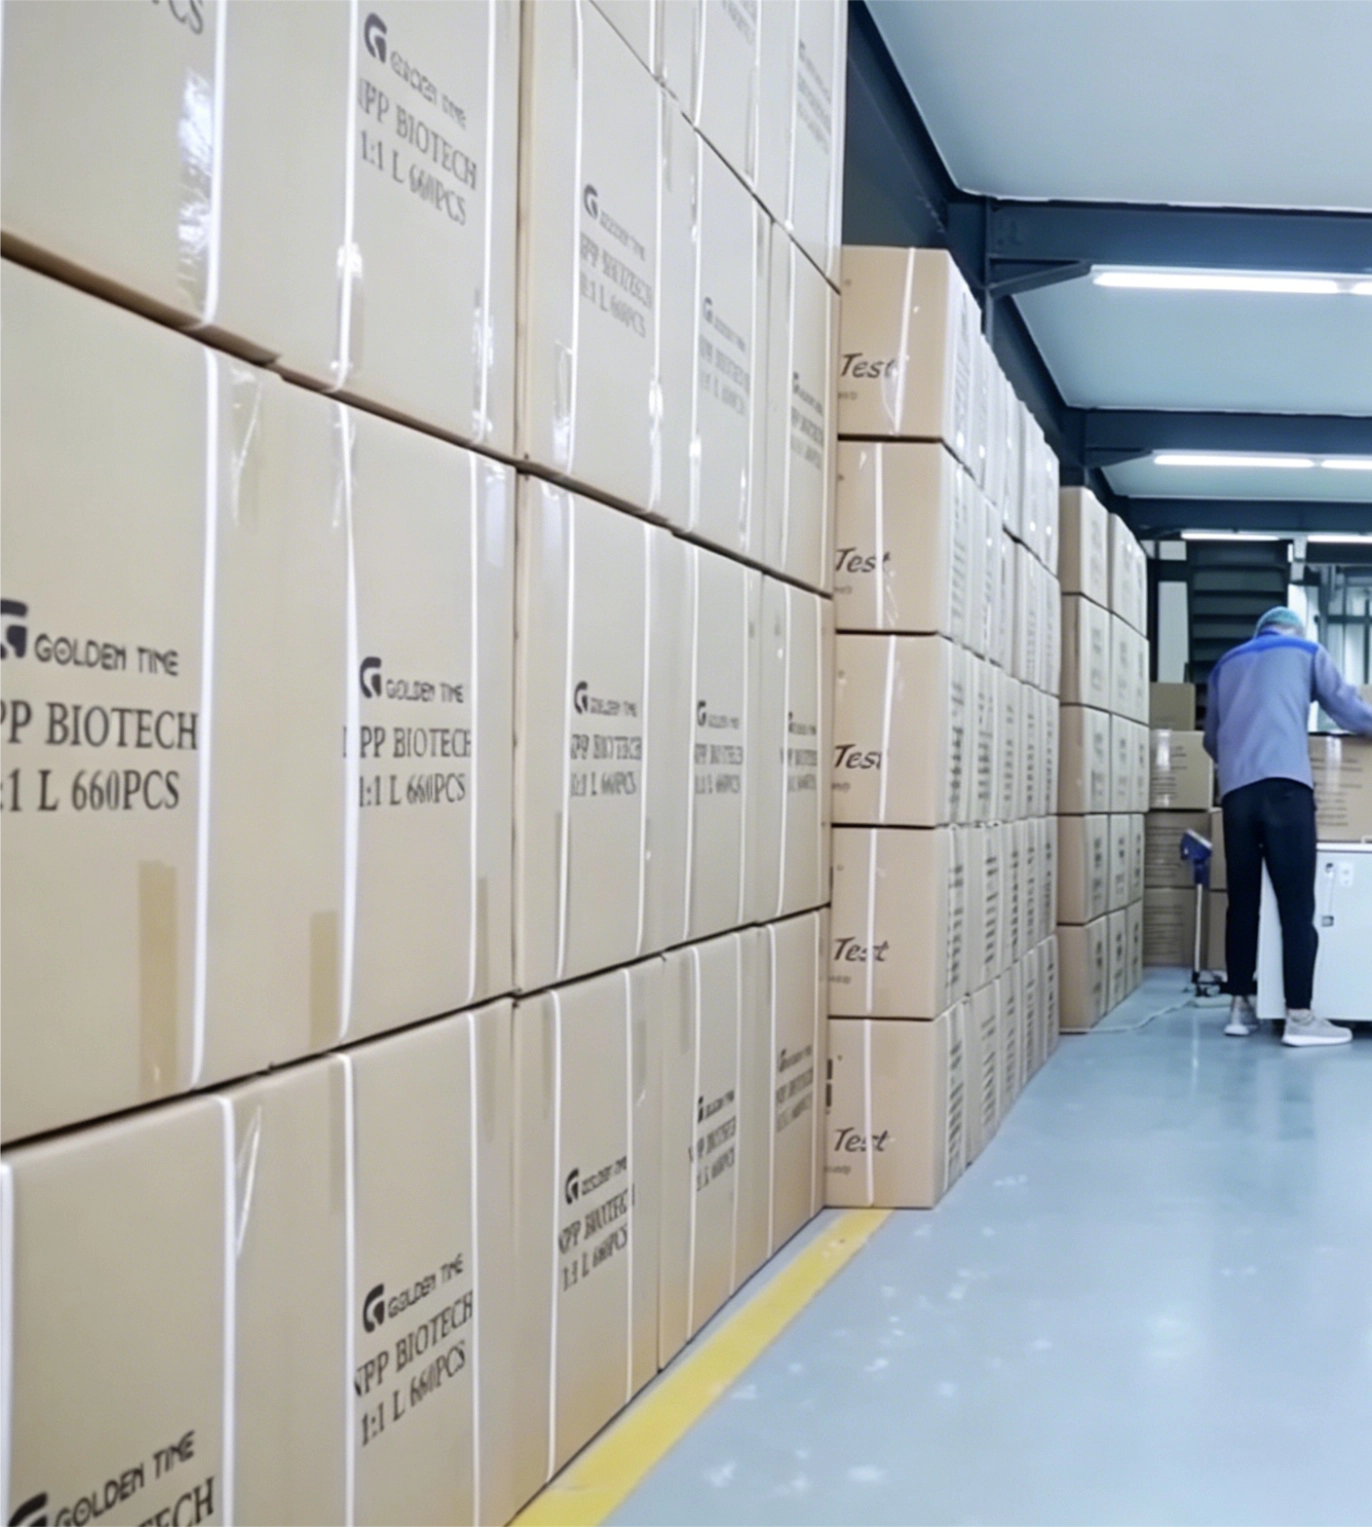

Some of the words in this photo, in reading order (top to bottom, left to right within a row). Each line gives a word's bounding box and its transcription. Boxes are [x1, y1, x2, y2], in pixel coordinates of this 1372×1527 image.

[396, 103, 477, 190] BIOTECH
[34, 633, 127, 672] GOLDEN
[137, 646, 179, 677] TIME
[45, 702, 198, 750] BIOTECH
[38, 769, 59, 811] L
[71, 769, 180, 812] 660PCS
[389, 774, 402, 805] L
[396, 1289, 473, 1373] BIOTECH
[392, 1389, 405, 1422] L
[152, 1429, 195, 1480] TIME
